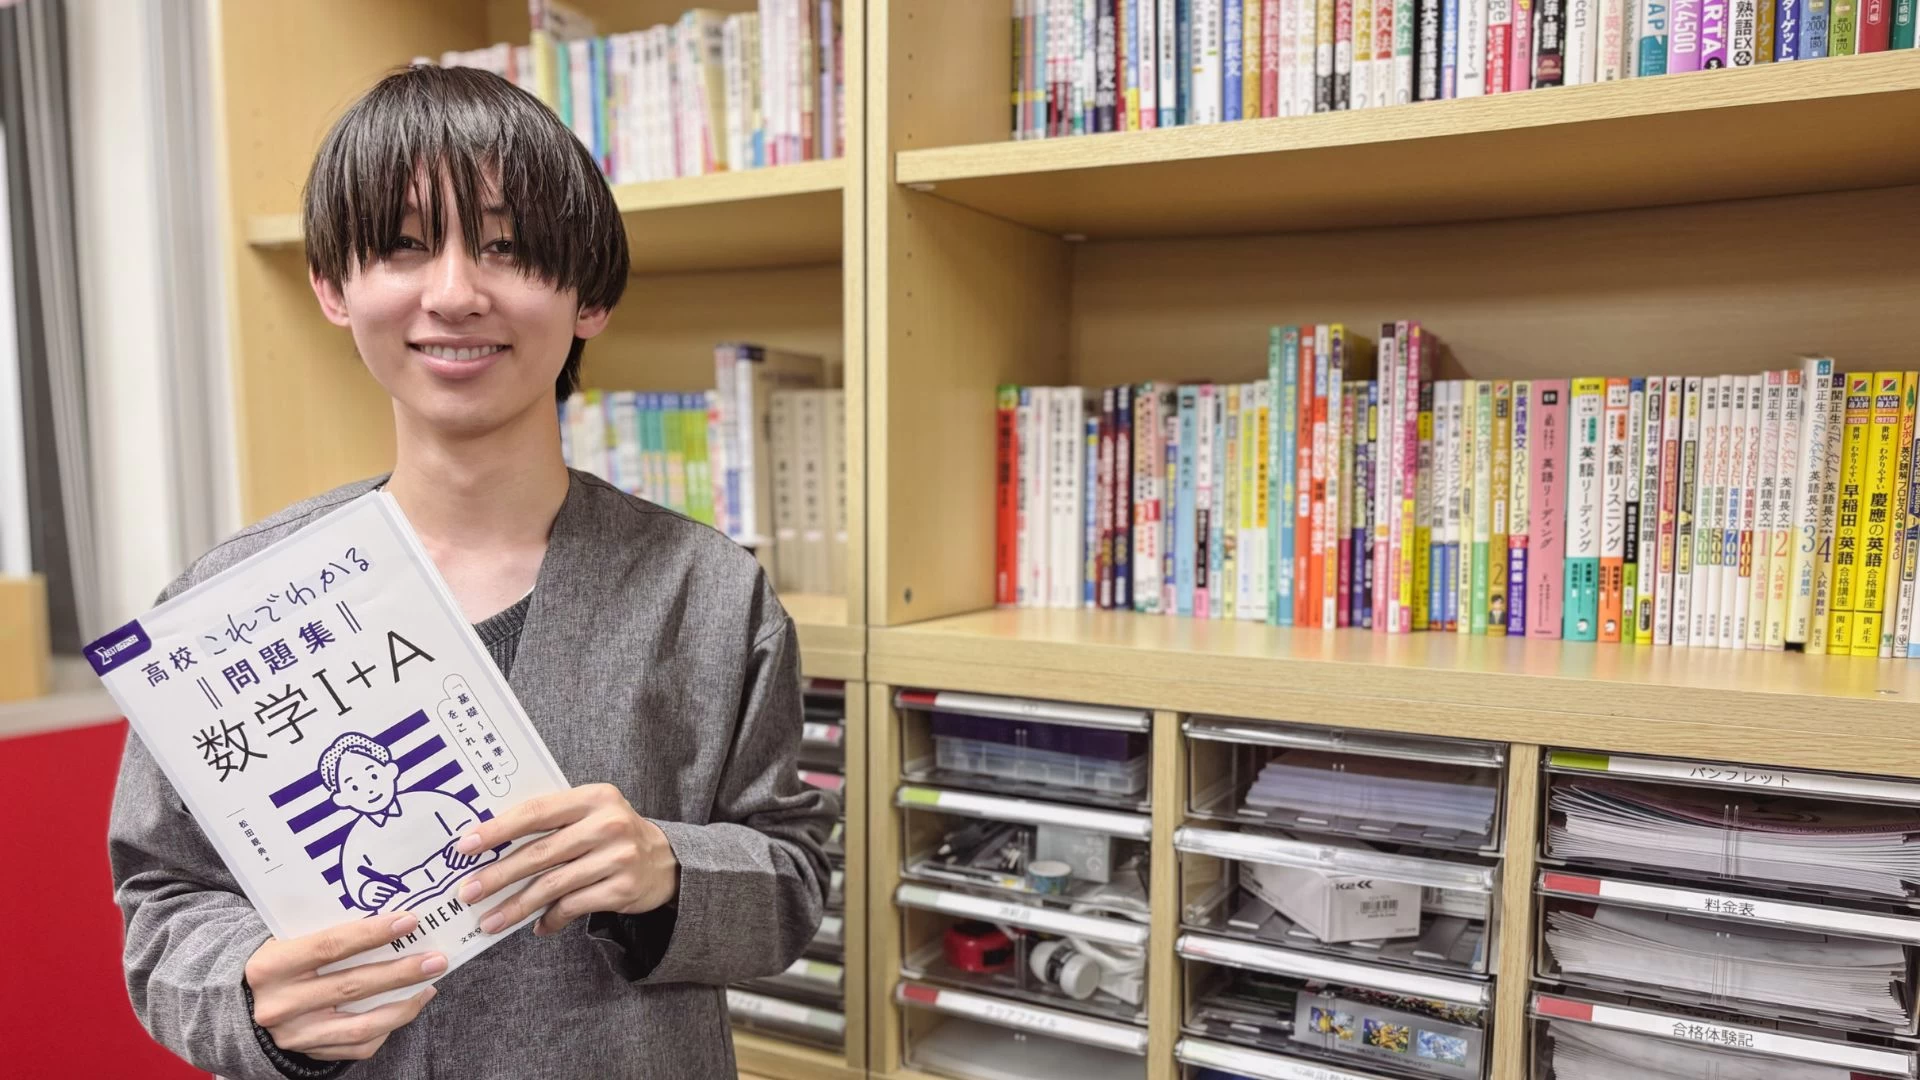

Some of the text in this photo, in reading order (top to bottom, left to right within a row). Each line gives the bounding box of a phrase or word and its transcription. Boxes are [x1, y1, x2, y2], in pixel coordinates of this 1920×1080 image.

[1806, 20, 1826, 31] 2000
[1833, 23, 1852, 34] 1500
[1579, 446, 1597, 552] 英語リーディング
[1605, 445, 1624, 552] 英語リスニング
[1805, 471, 1821, 517] 英語長文
[1822, 481, 1837, 528] 英語長文
[1838, 484, 1859, 565] 早稲田の英語
[1863, 425, 1890, 609] 世界一わかりやすい 慶應の英語 合格講座
[1710, 528, 1722, 564] 500
[1725, 529, 1737, 566] 700
[1740, 530, 1752, 576] 1000
[1760, 529, 1768, 557] 1
[1774, 529, 1788, 557] 2
[1802, 525, 1816, 553] 3
[1817, 535, 1832, 563] 4
[141, 547, 369, 687] 高校 これでわかる
[222, 619, 336, 695] 問題集
[1689, 767, 1791, 788] パンフレット
[1704, 897, 1756, 917] 料金表
[1671, 1021, 1755, 1048] 合格体験記
